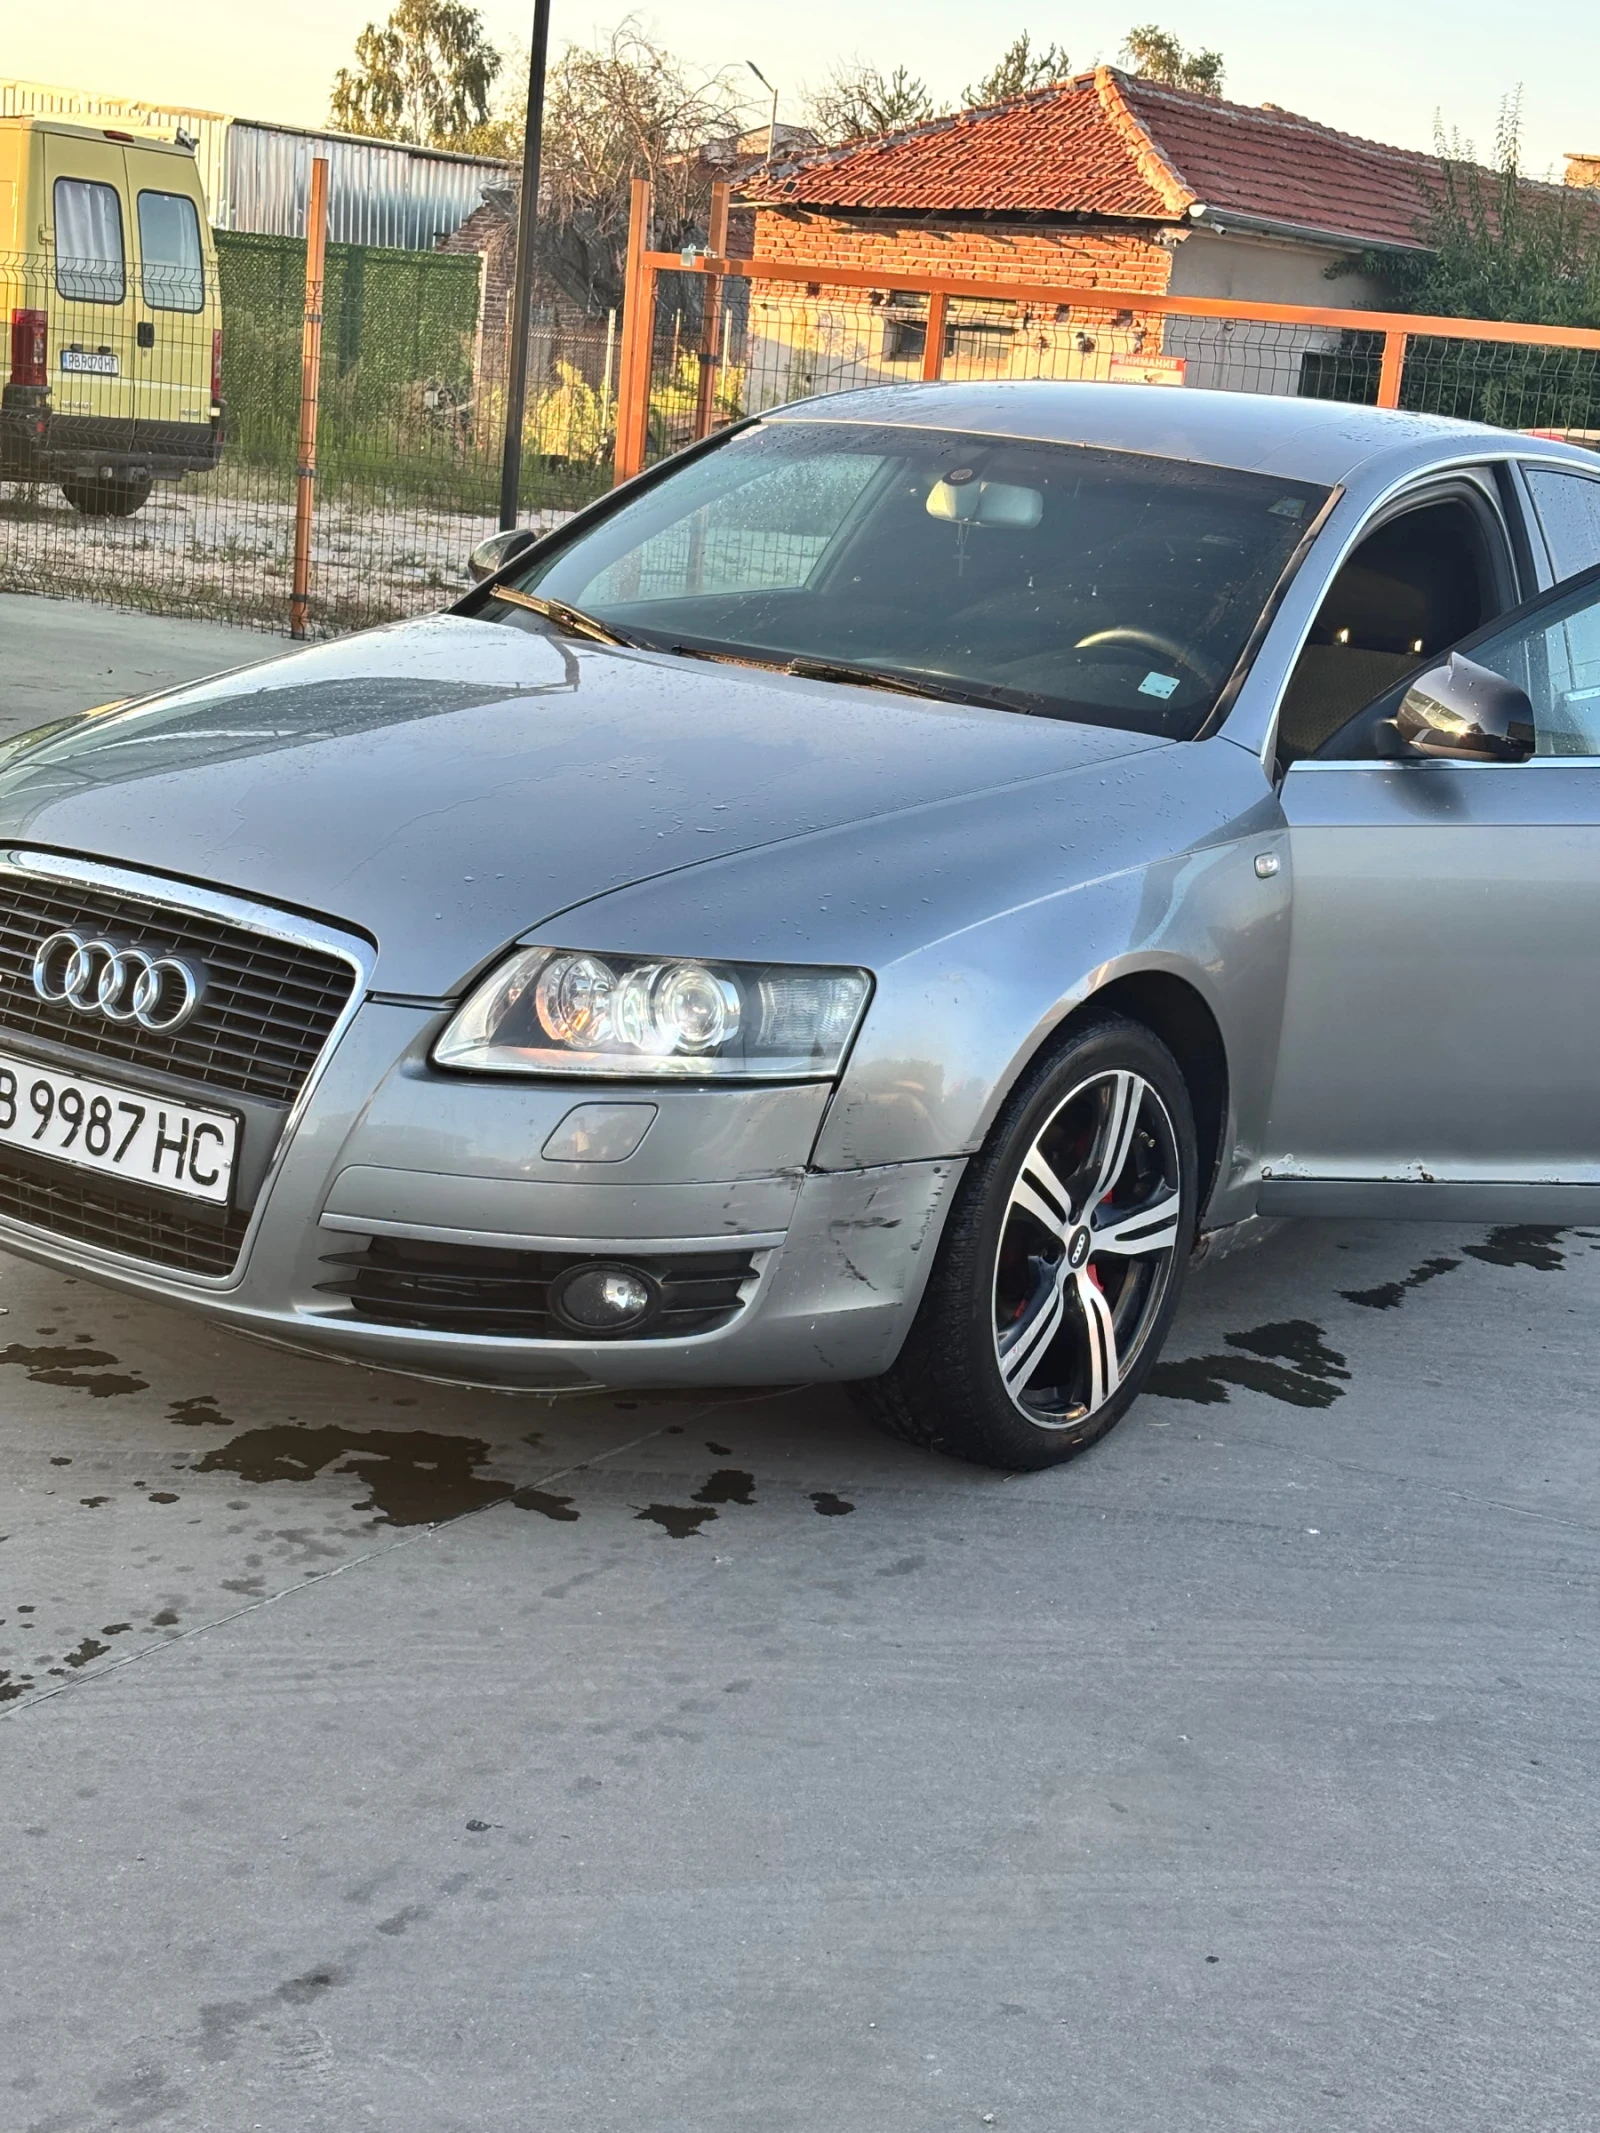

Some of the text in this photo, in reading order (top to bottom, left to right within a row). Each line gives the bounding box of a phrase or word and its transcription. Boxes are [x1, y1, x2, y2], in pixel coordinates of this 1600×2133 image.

[1118, 354, 1177, 369] ВНИМАНИЕ
[29, 1079, 146, 1163] 9987
[152, 1111, 224, 1187] HC
